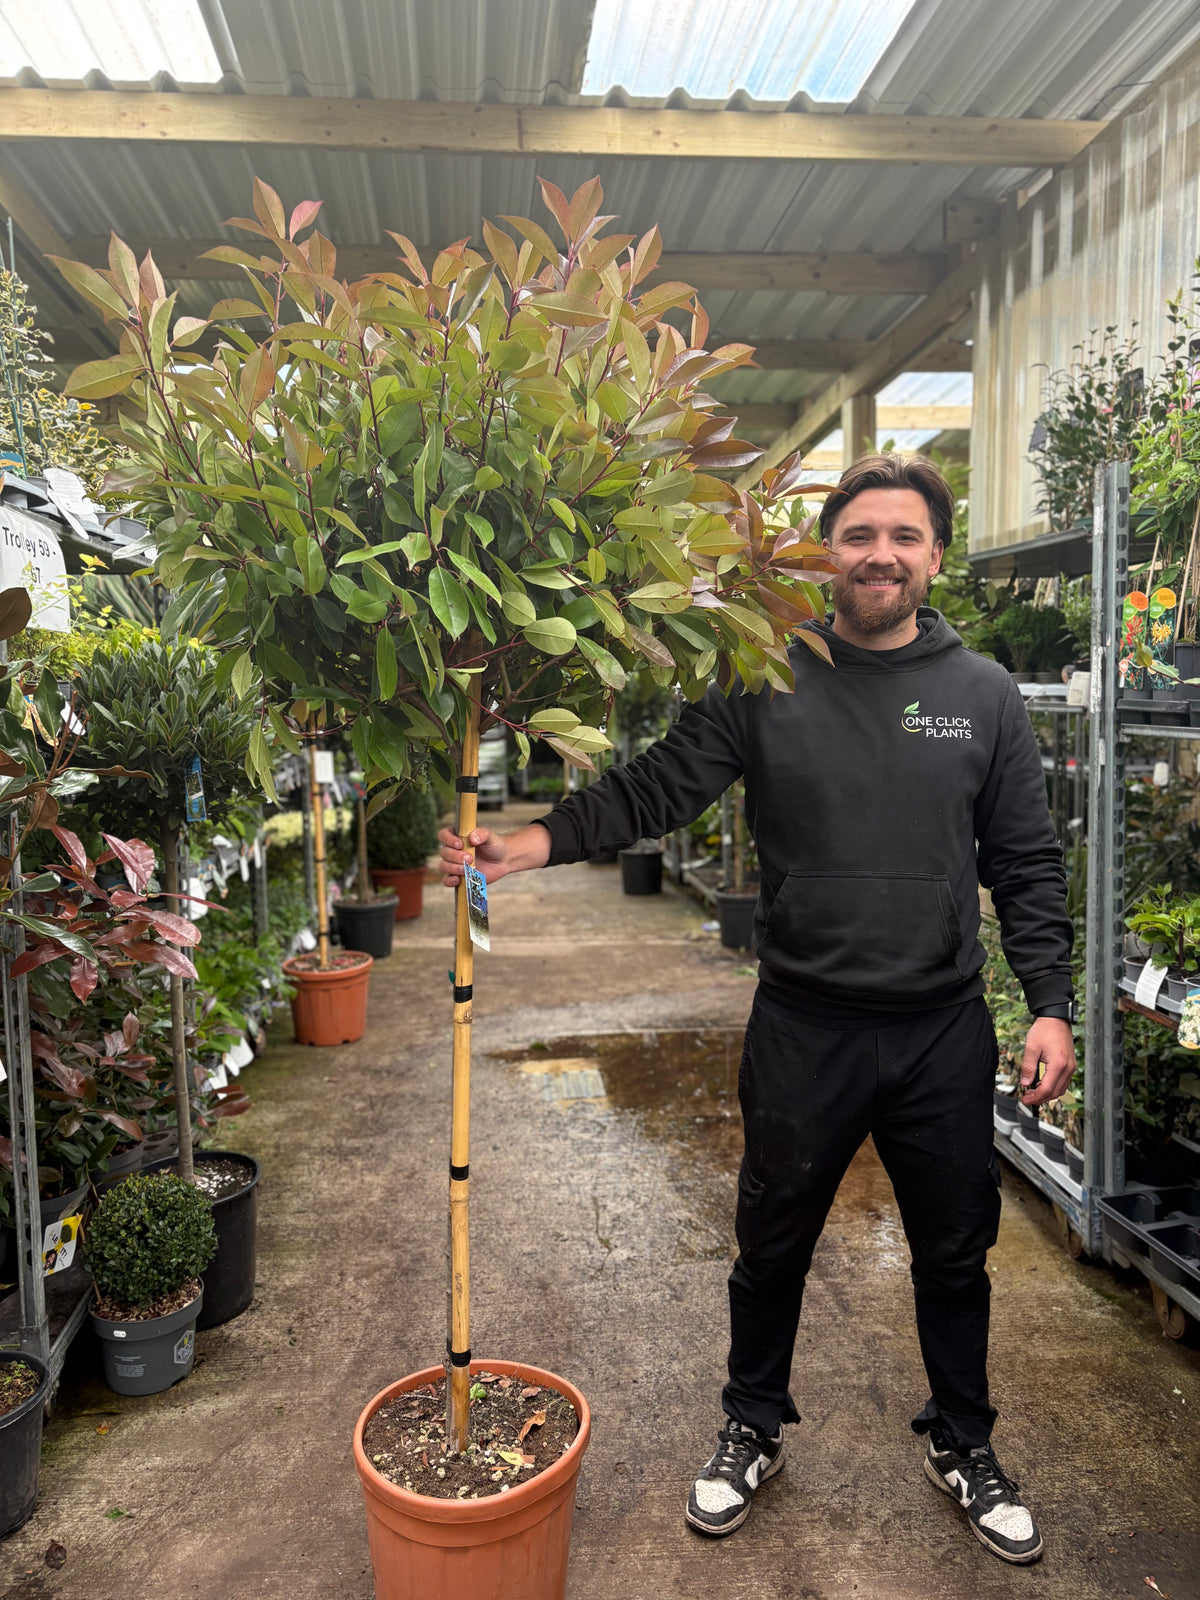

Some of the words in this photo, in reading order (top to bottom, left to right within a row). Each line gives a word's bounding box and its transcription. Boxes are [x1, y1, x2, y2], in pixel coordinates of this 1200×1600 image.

[2, 526, 36, 558] Trolley
[38, 538, 50, 558] 59
[905, 716, 933, 727] ONE
[935, 716, 972, 728] CLICK
[925, 728, 972, 739] PLANTS
